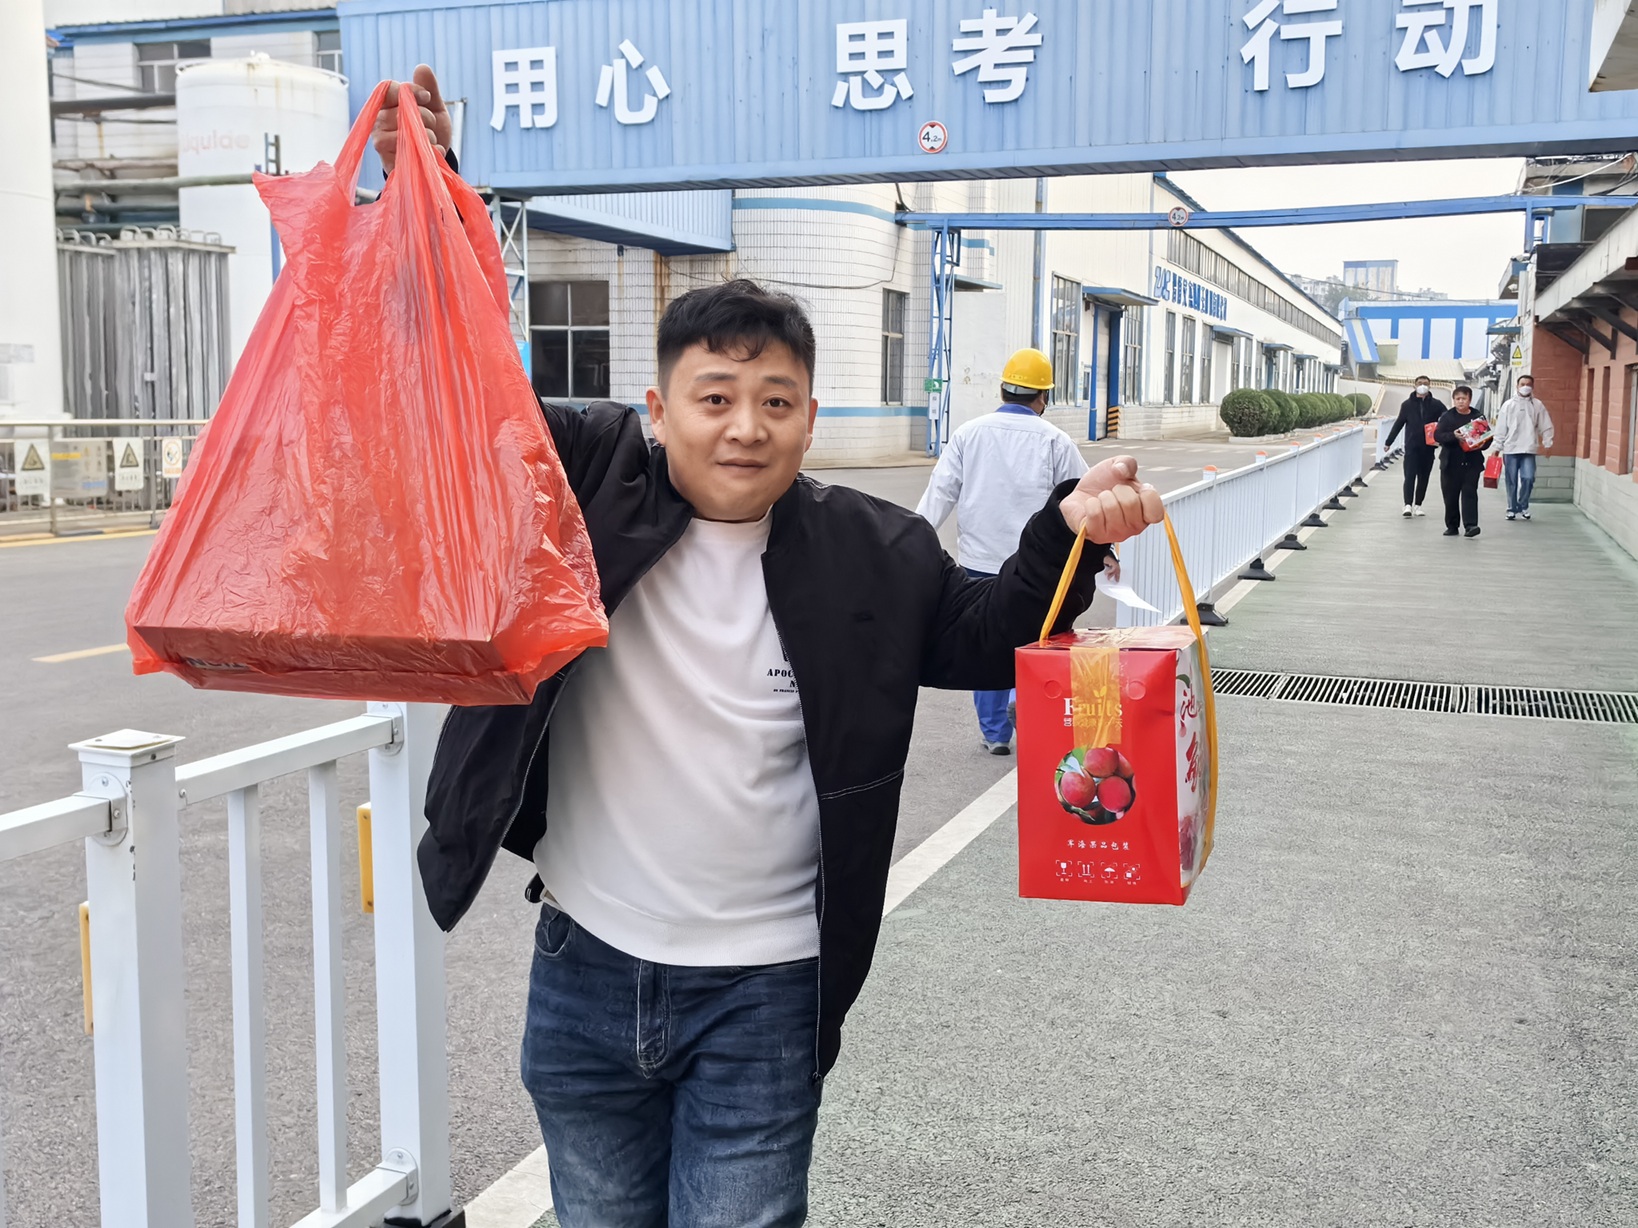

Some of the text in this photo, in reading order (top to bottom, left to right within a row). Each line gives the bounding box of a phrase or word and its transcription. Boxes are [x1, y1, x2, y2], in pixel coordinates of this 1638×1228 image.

[489, 0, 1499, 132] 用心 思考 行动
[922, 131, 942, 142] 4.2m
